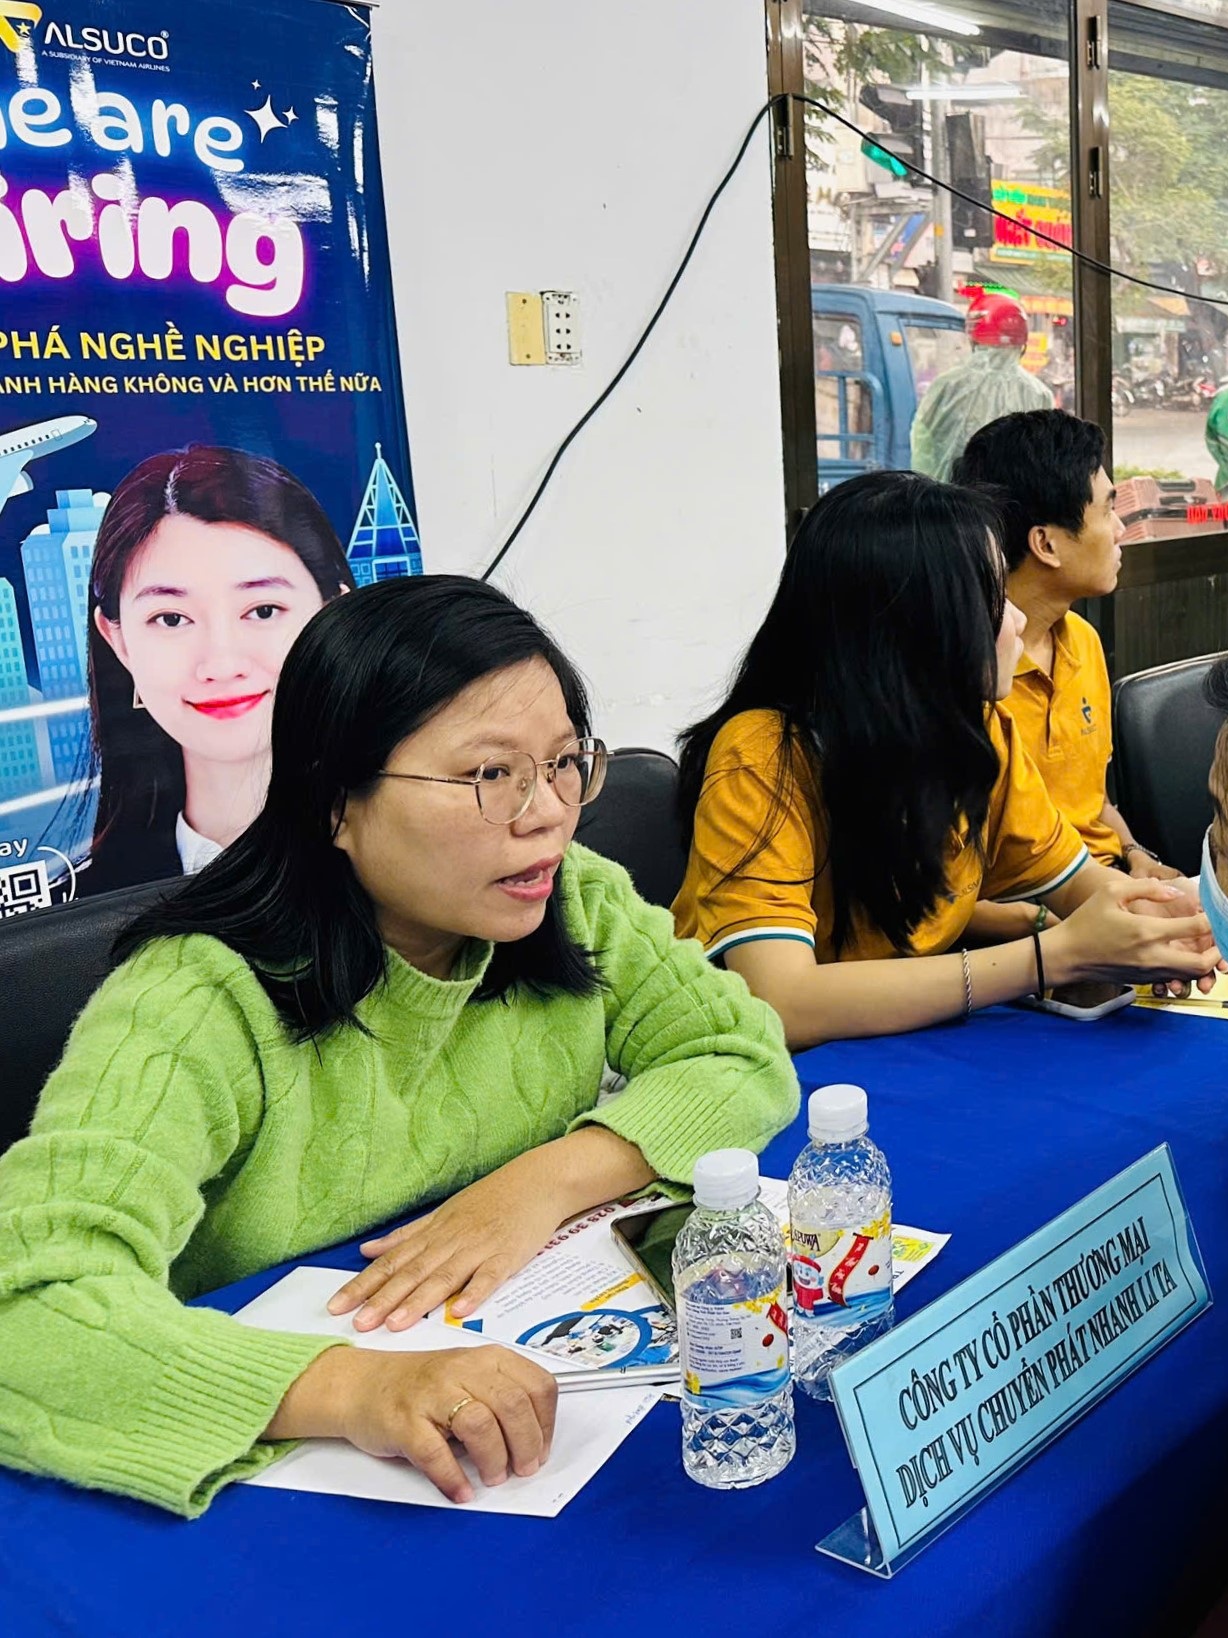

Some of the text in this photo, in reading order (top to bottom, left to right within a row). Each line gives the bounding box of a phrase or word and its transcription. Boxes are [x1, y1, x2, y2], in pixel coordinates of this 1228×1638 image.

[49, 51, 92, 62] SUBSIDIARY
[92, 56, 103, 64] OF
[104, 56, 137, 68] VIETNAM
[138, 63, 171, 73] AIRLINES
[0, 87, 245, 172] e are
[80, 321, 187, 361] NGHỀ
[195, 329, 326, 368] NGHIỆP
[0, 369, 382, 394] NH HÀNG KHÔNG VÀ HƠN THẾ NỮA
[899, 1361, 958, 1430] CÔNG
[953, 1338, 984, 1390] TY
[1006, 1284, 1058, 1351] PHẦN
[1052, 1238, 1122, 1315] THƯƠNG
[1116, 1216, 1151, 1268] MẠI
[895, 1435, 953, 1508] DỊCH
[946, 1413, 980, 1466] VỤ
[977, 1357, 1052, 1443] CHUYỂN
[1044, 1321, 1092, 1389] PHÁT
[1085, 1280, 1147, 1354] NHANH
